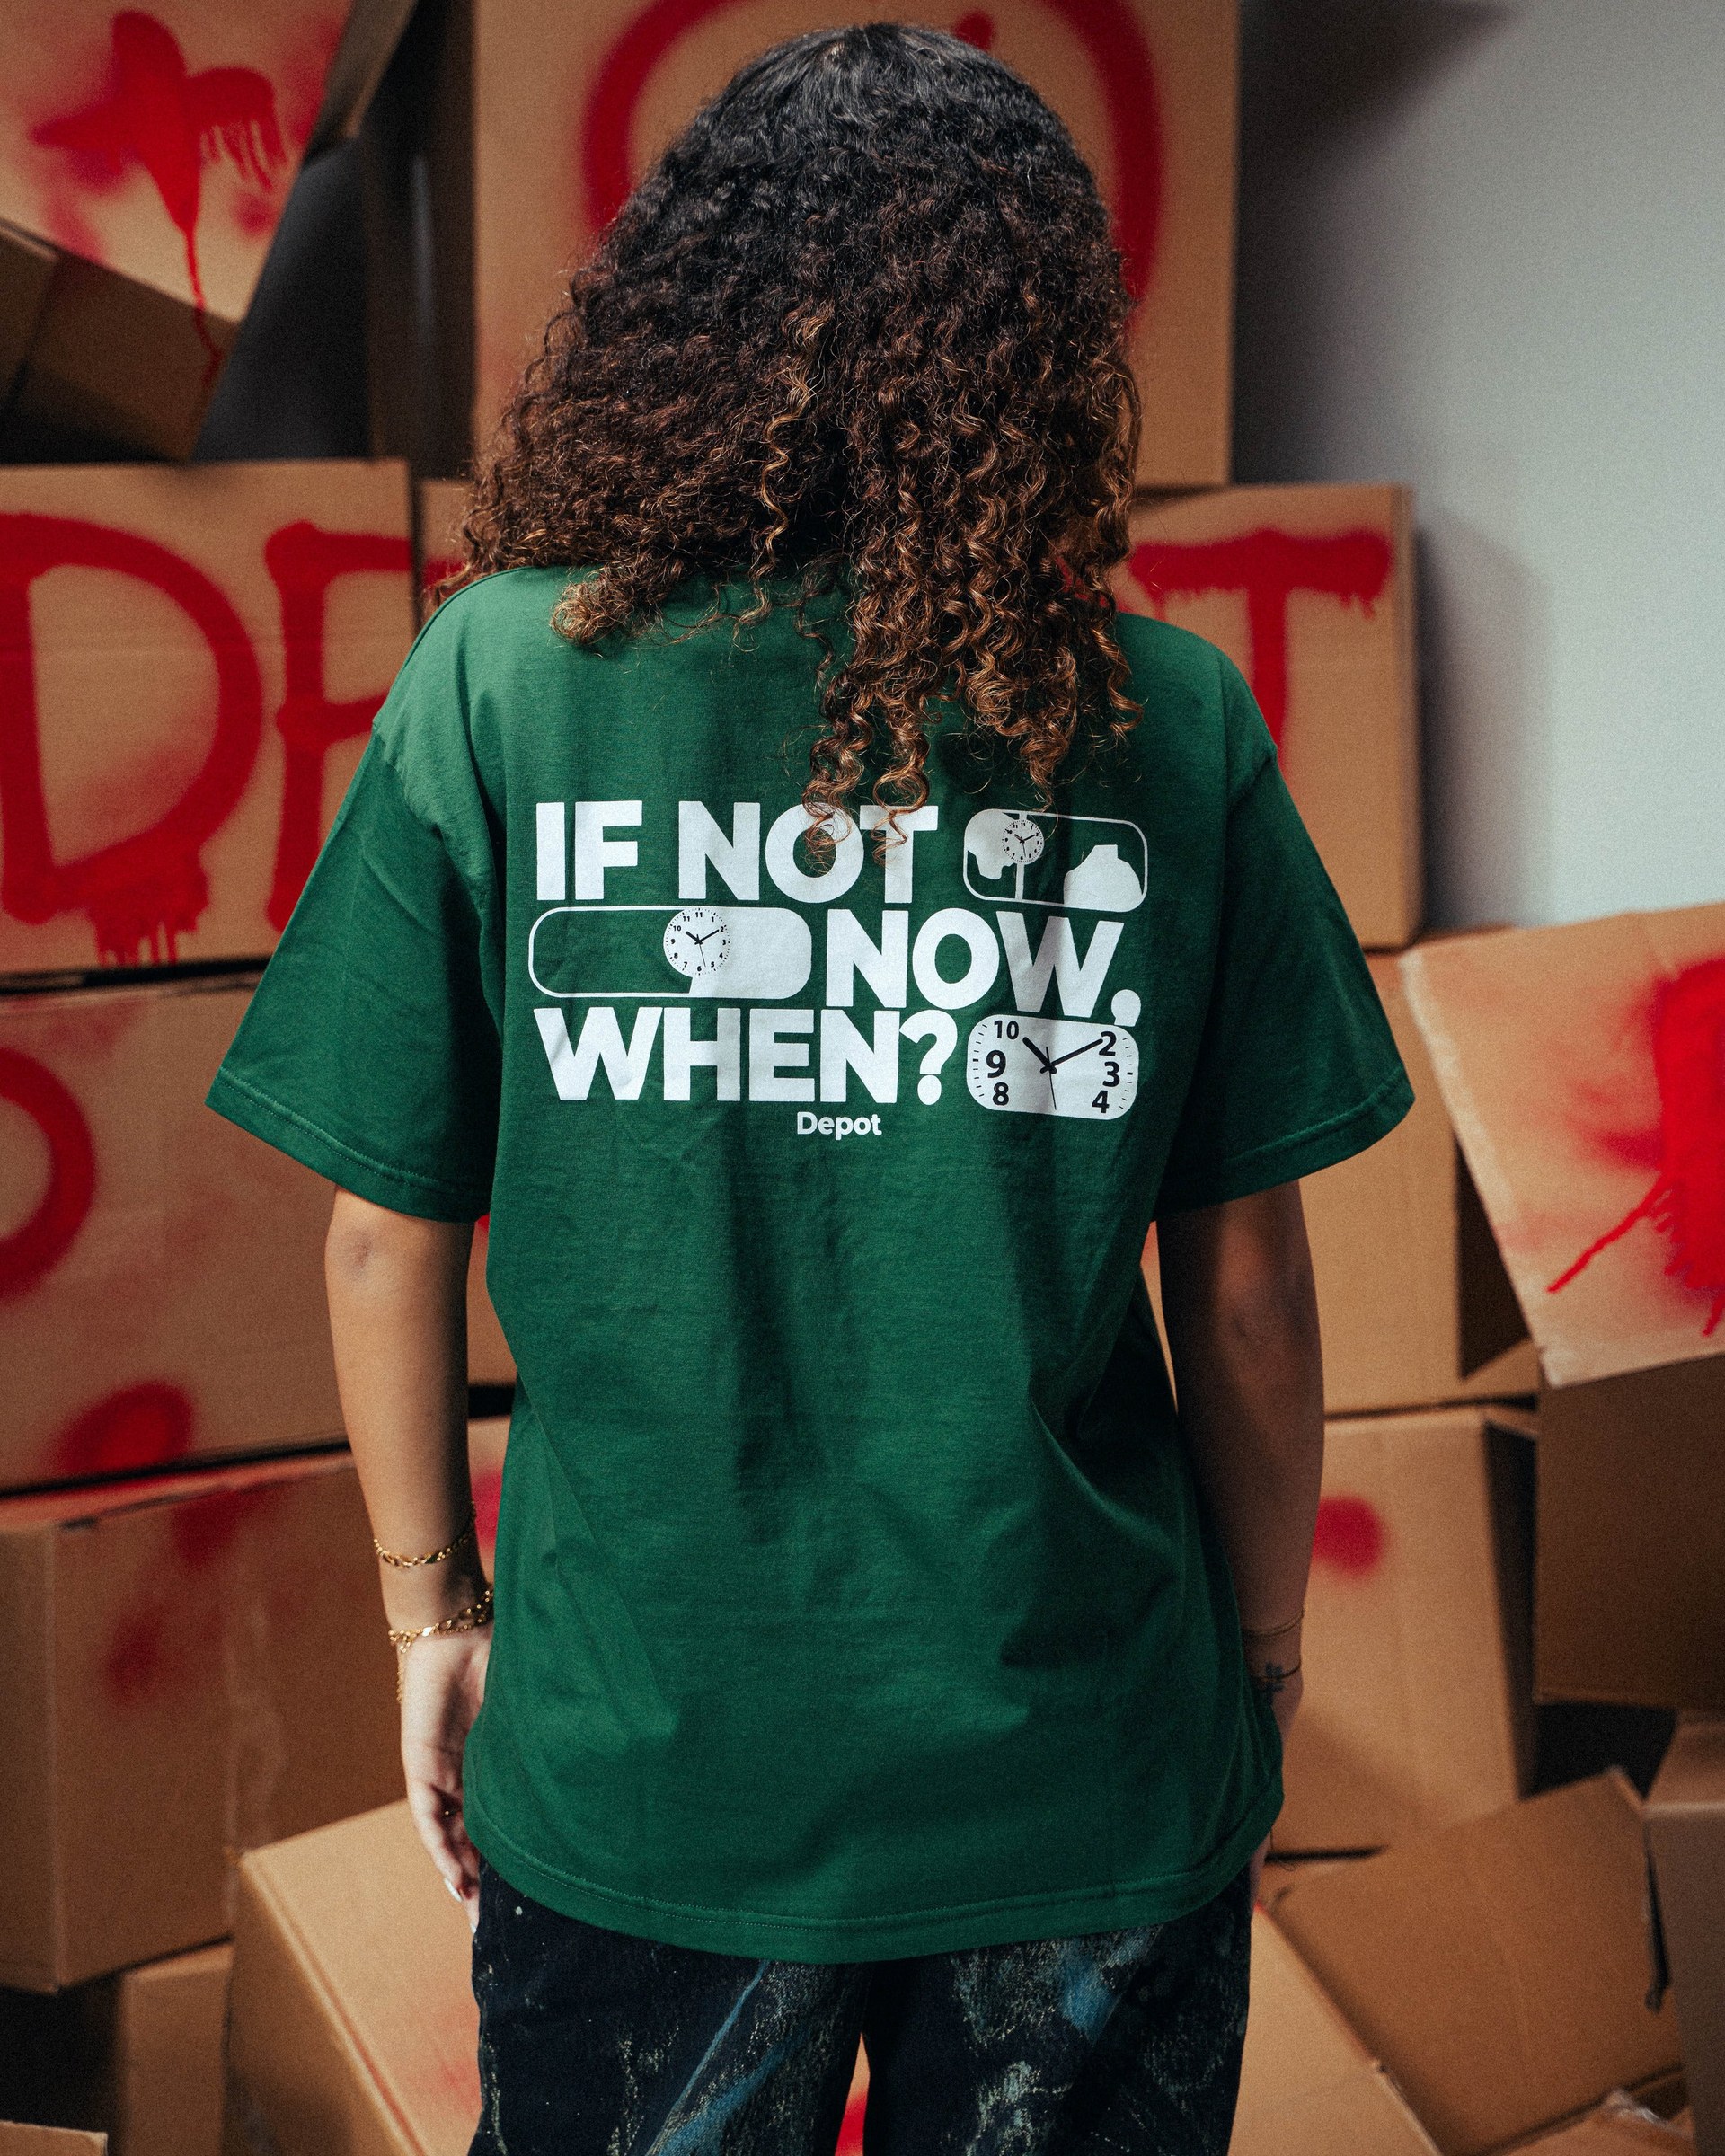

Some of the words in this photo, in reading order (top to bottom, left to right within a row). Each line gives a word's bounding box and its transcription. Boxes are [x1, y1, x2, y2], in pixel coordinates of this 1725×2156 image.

[535, 800, 643, 900] IF
[678, 802, 939, 904] NOT
[994, 1020, 1020, 1040] 10
[1098, 1030, 1117, 1057] 2
[533, 1006, 959, 1106] WHEN?
[986, 1049, 1006, 1079] 9
[1102, 1061, 1120, 1088] 3
[992, 1082, 1010, 1106] 8
[1091, 1090, 1110, 1114] 4
[796, 1111, 882, 1141] Depot
